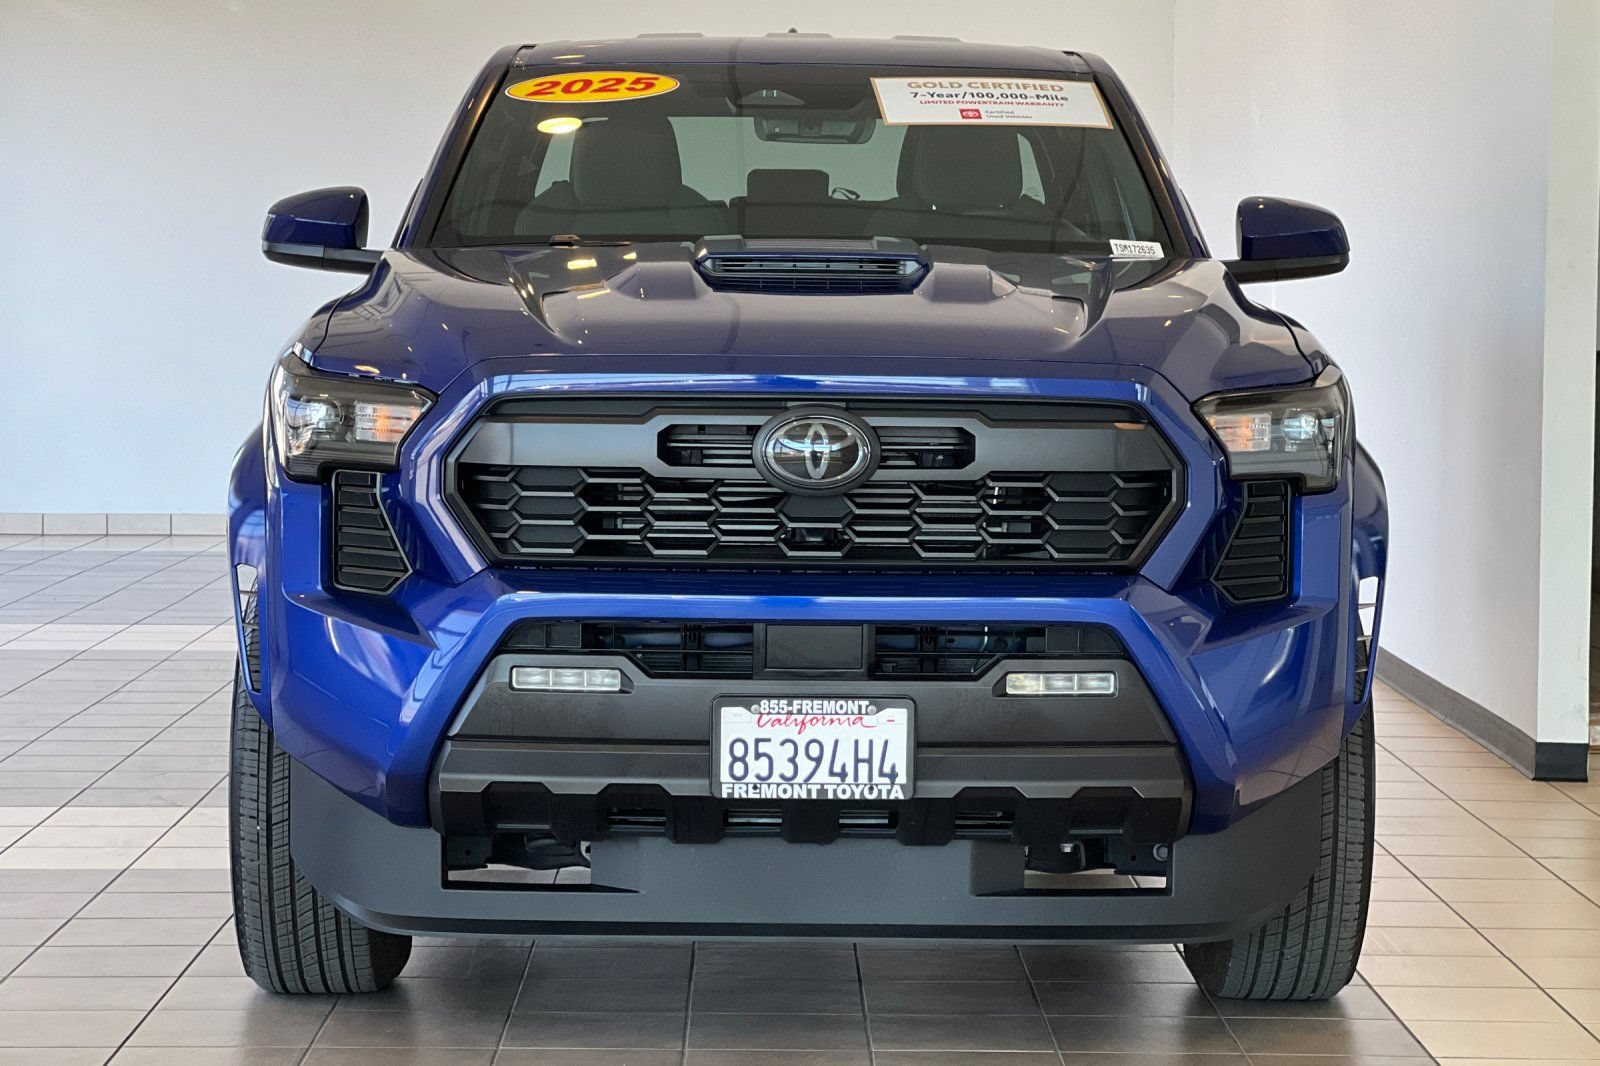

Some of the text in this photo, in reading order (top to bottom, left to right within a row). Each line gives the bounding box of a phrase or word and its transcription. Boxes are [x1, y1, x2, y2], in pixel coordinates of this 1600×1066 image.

[524, 76, 661, 97] 2025
[907, 81, 1065, 92] GOLD CERTIFIED
[909, 91, 1069, 102] 7-Year/100,000-Mile
[759, 700, 870, 715] 855-FREMONT
[756, 714, 877, 735] California
[728, 737, 899, 784] 85394H4
[721, 784, 905, 800] FREMONT TOYOTA
